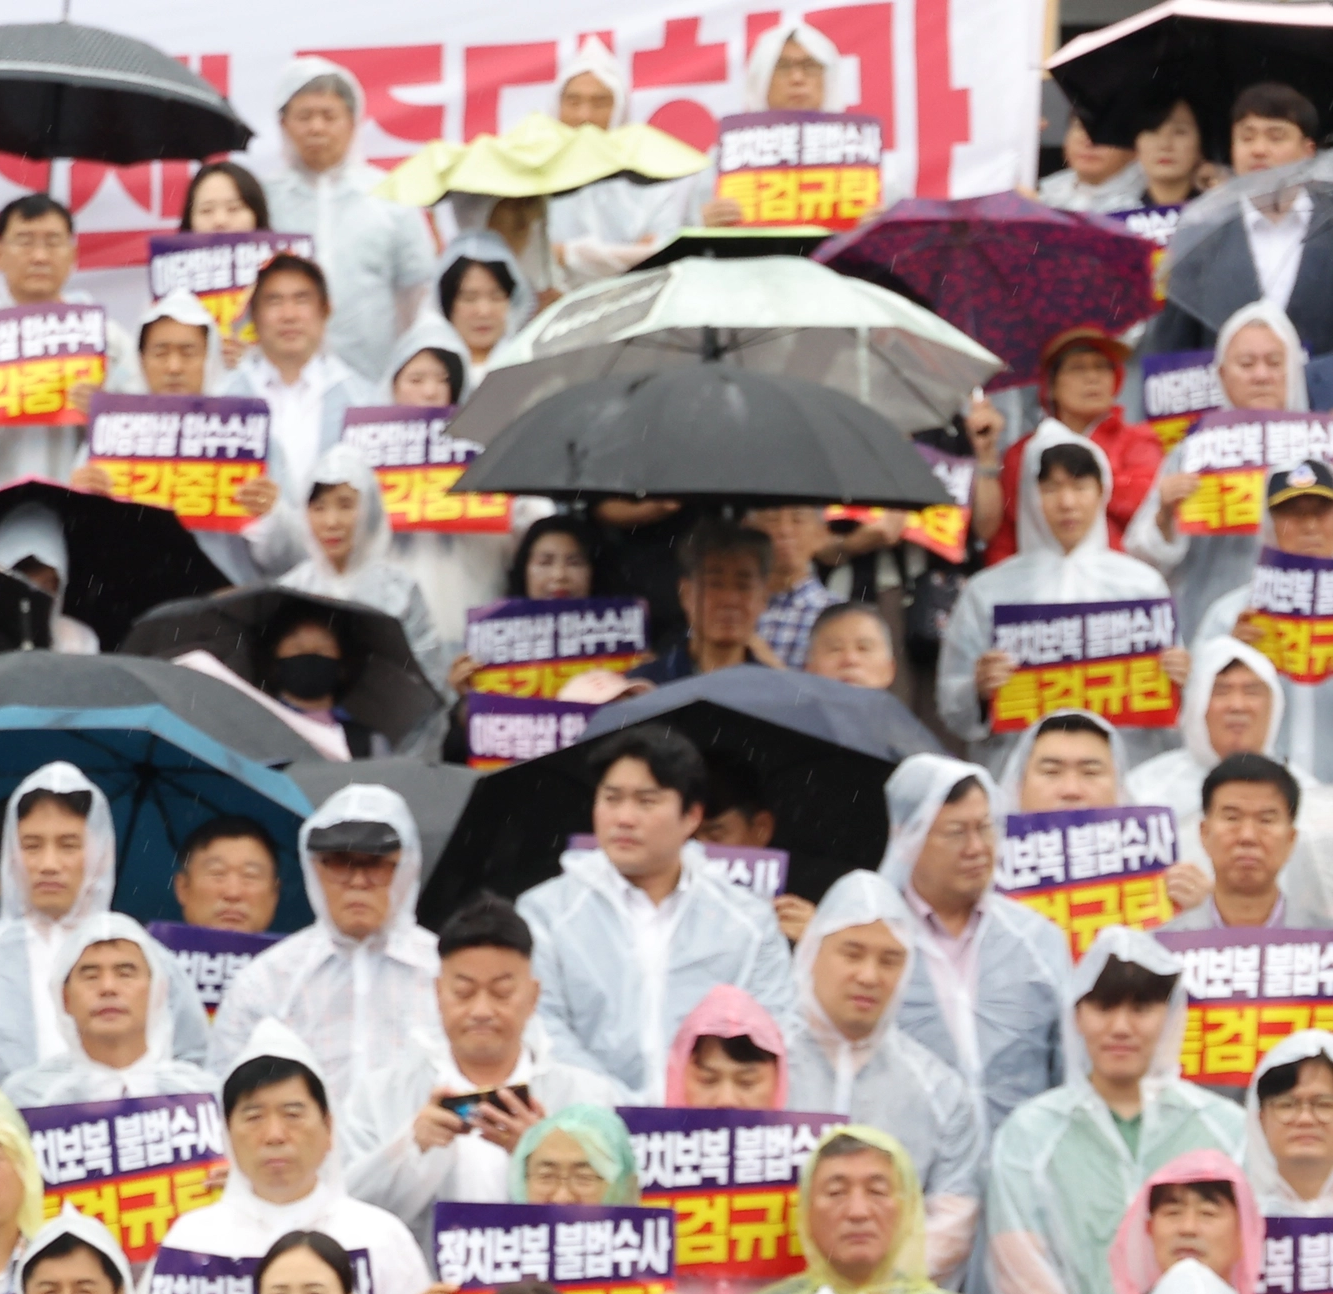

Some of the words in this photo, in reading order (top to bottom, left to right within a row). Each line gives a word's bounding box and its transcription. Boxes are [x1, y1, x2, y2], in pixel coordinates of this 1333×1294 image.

[721, 127, 800, 172] 정치보복
[804, 121, 882, 163] 불법수사
[718, 171, 879, 219] 특검규탄
[22, 311, 104, 359] 압수수색
[93, 411, 178, 456] 야당말살
[183, 410, 268, 457] 압수수색
[1180, 471, 1265, 528] 특검
[469, 616, 553, 664] 야당말살
[558, 605, 644, 656] 압수수색
[997, 622, 1083, 668] 정치보복
[1086, 602, 1177, 658] 불법수사
[997, 656, 1180, 728] 특검규탄
[997, 834, 1064, 888] 치보복
[1069, 812, 1177, 874] 불법수사
[36, 1119, 111, 1180] 치보복
[115, 1101, 222, 1174] 불법수사
[438, 1228, 549, 1286] 정치보복
[555, 1219, 671, 1278] 불법수사
